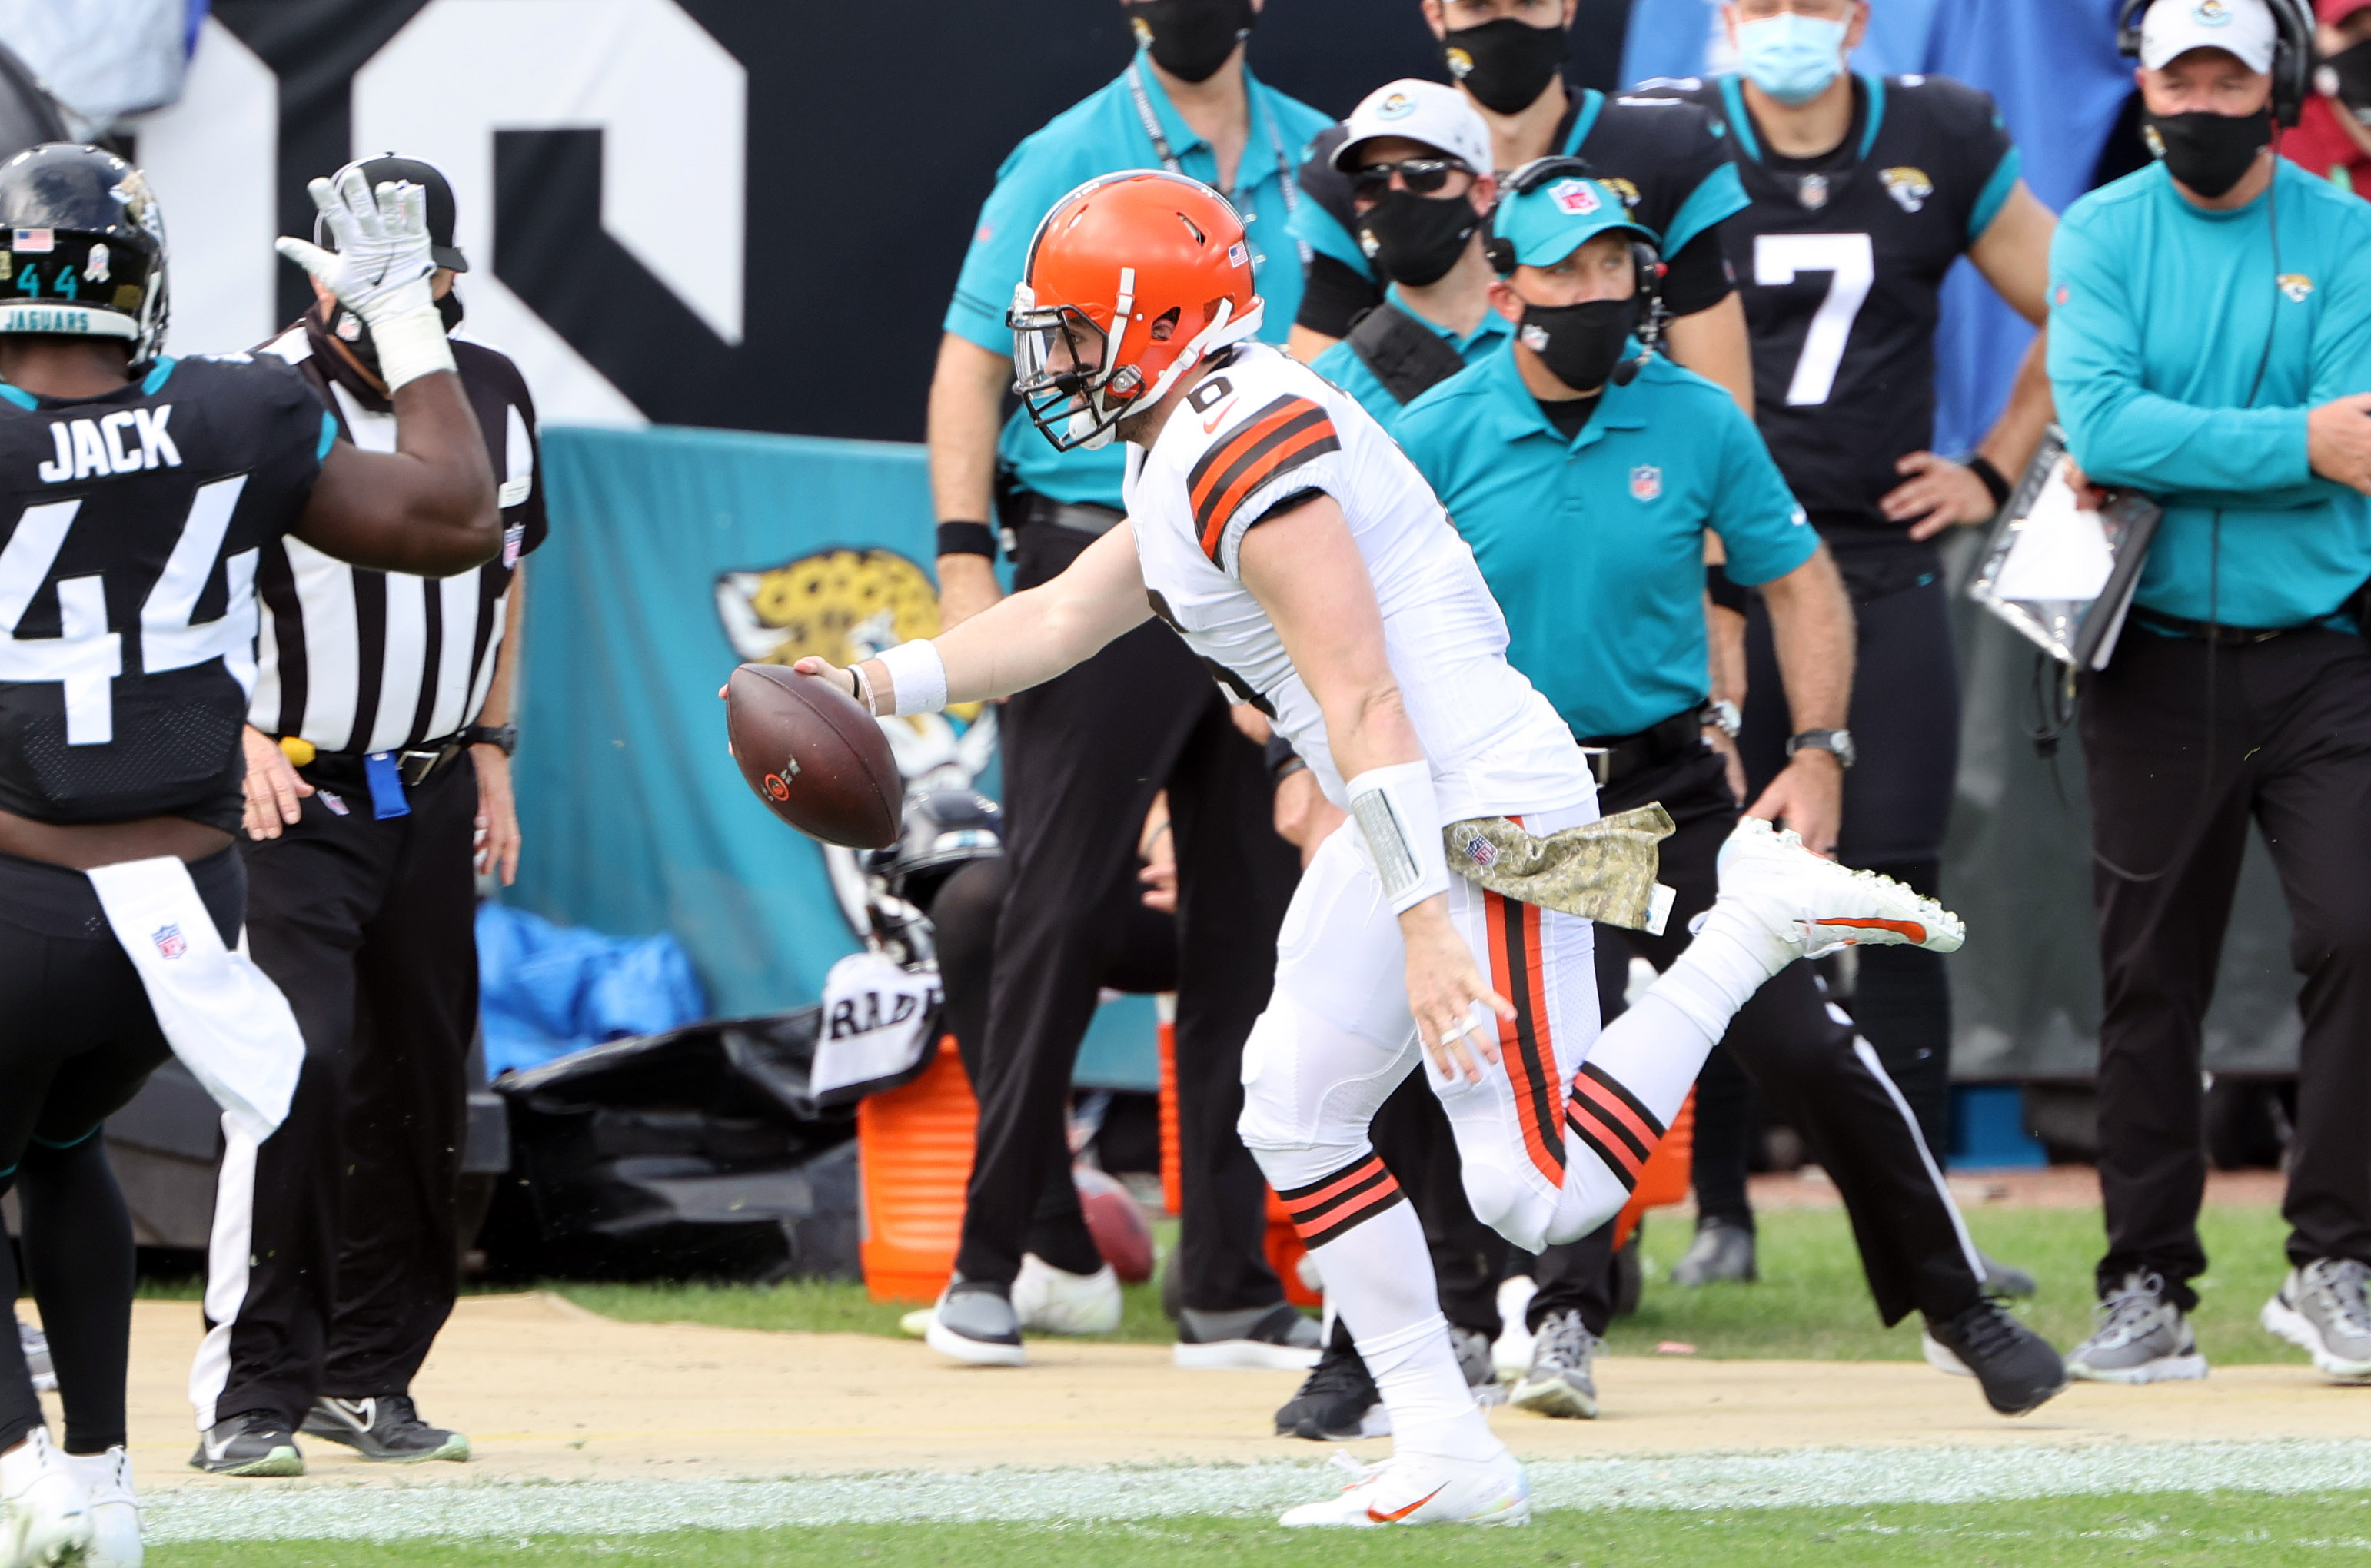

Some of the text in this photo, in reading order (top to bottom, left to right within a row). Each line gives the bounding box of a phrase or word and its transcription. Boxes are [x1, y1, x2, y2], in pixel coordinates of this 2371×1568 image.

[6, 310, 89, 332] JAGUARS
[1754, 233, 1874, 407] 7
[39, 404, 183, 483] JACK
[0, 473, 261, 746] 44
